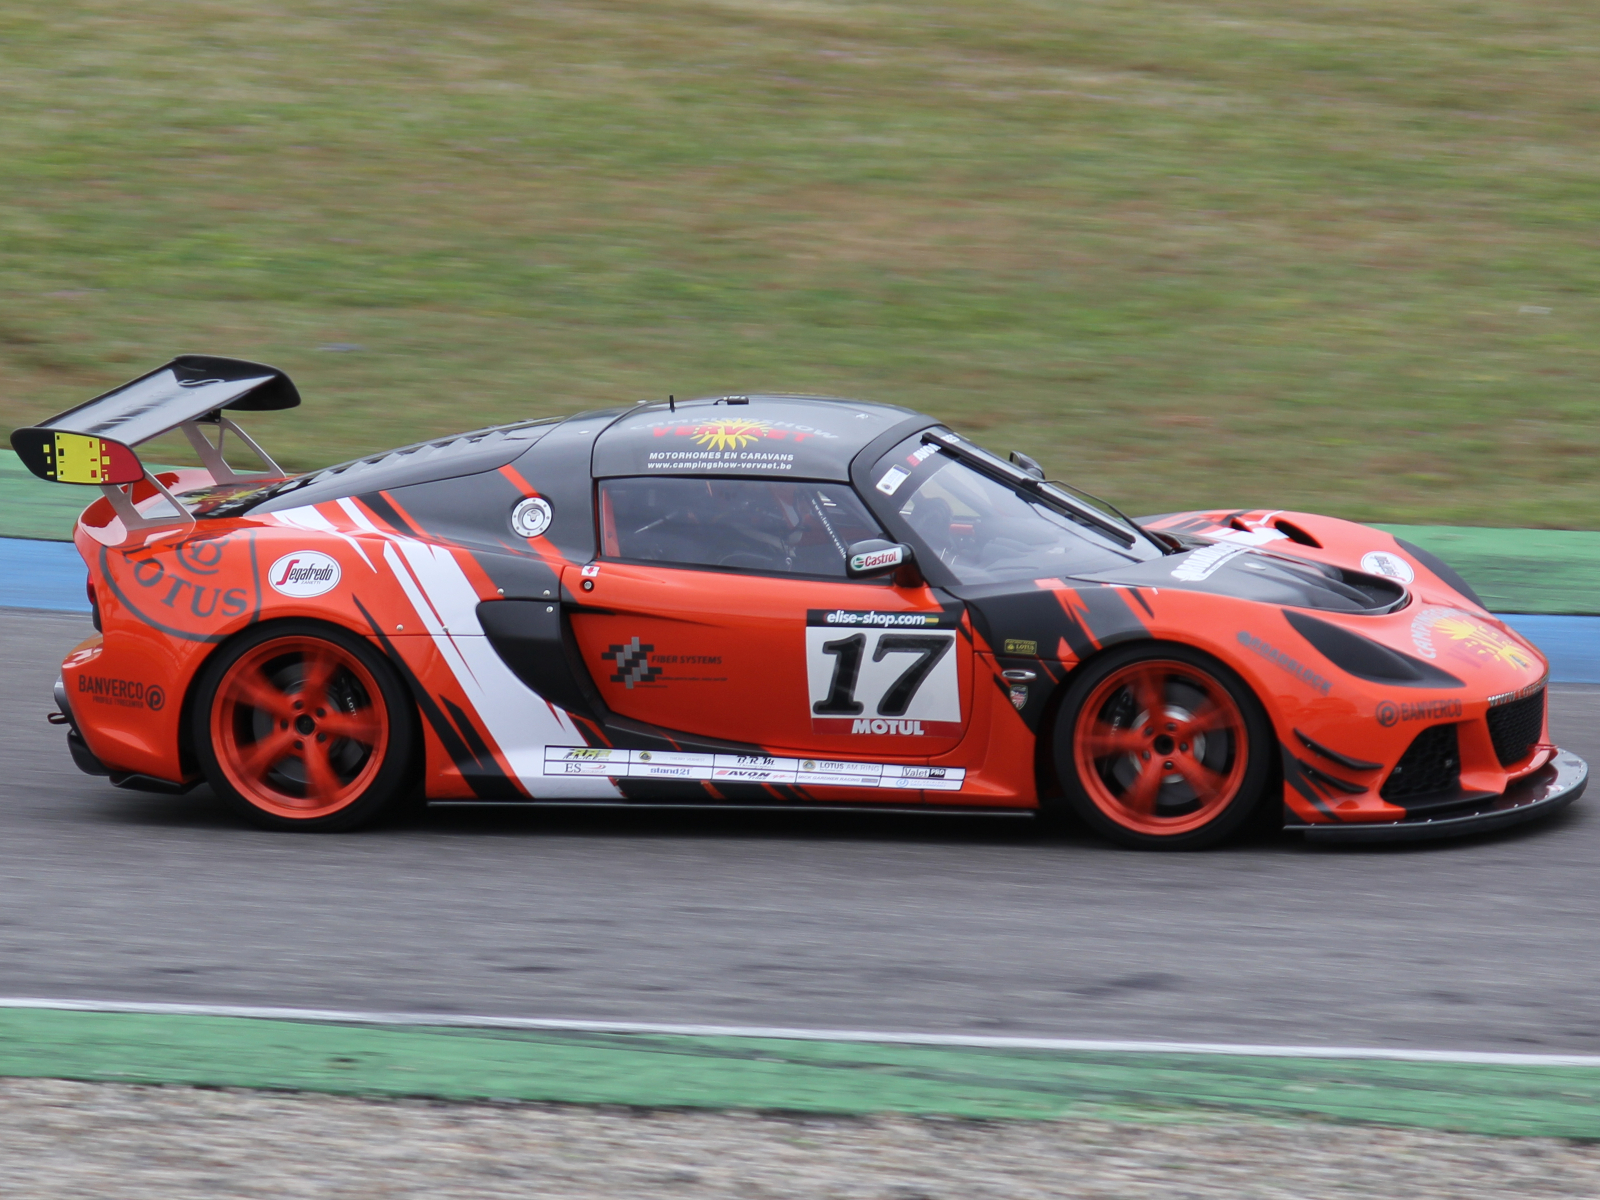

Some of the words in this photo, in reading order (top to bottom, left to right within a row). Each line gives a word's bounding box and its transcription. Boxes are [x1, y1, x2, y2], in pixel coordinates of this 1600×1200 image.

[652, 425, 815, 442] VERVAET
[649, 451, 721, 460] MOTORHOMES
[724, 452, 738, 460] EN
[740, 452, 794, 461] CARAVANS
[647, 460, 792, 470] www.campingshow-vervaet.be
[865, 551, 897, 567] Castrol
[275, 559, 334, 585] Segafredo
[826, 610, 926, 627] elise-shop.com
[651, 655, 678, 664] FIBER
[680, 656, 723, 665] SYSTEMS
[813, 633, 955, 716] 17
[78, 675, 144, 700] BANVERCO
[1401, 699, 1463, 721] BANVERCO
[852, 719, 925, 736] MOTUL
[564, 763, 582, 773] ES
[819, 762, 844, 770] LOTUS
[860, 764, 880, 772] RING
[905, 767, 928, 777] Valet
[930, 768, 945, 776] PRO
